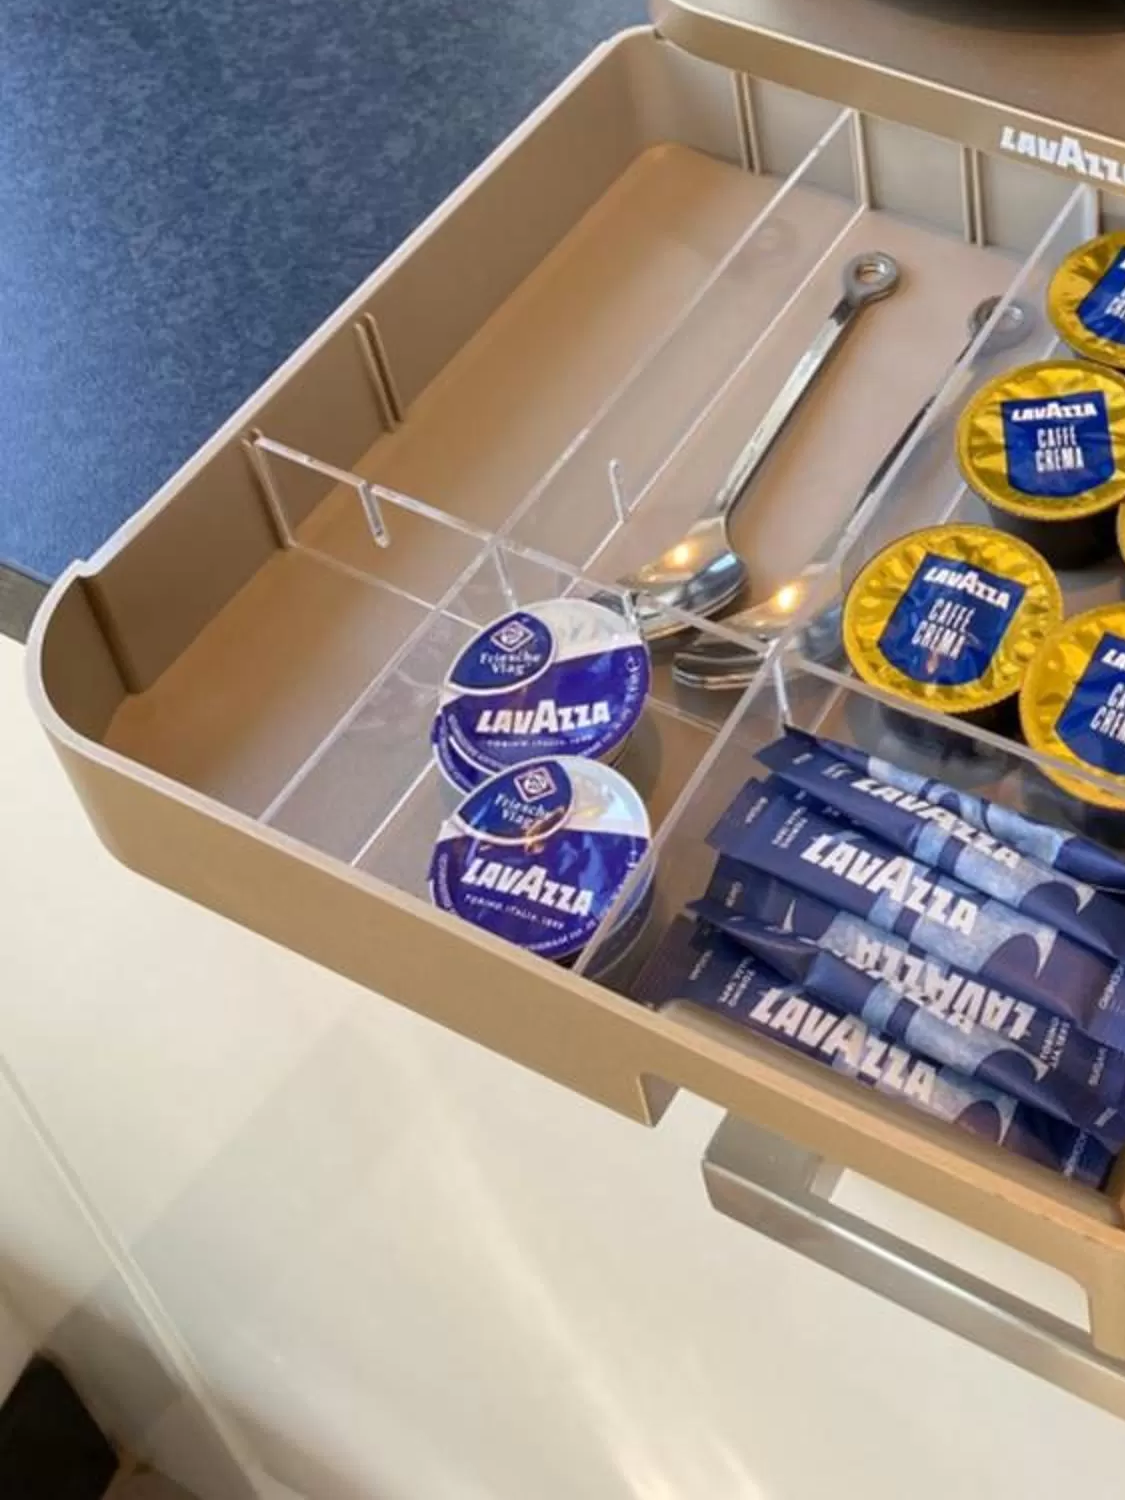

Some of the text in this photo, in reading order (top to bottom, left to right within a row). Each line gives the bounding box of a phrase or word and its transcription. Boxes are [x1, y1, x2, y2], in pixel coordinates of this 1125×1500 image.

[1011, 401, 1098, 421] LAVAZZA
[1035, 446, 1084, 473] CREMA
[923, 567, 1010, 611] LAVAZZA
[911, 620, 965, 660] CREMA
[476, 699, 610, 735] LAVAZZA
[851, 779, 1021, 869] LAVAZZA
[460, 857, 594, 917] LAVAZZA
[801, 834, 978, 936] LAVAZZA
[750, 987, 937, 1104] LAVAZZA
